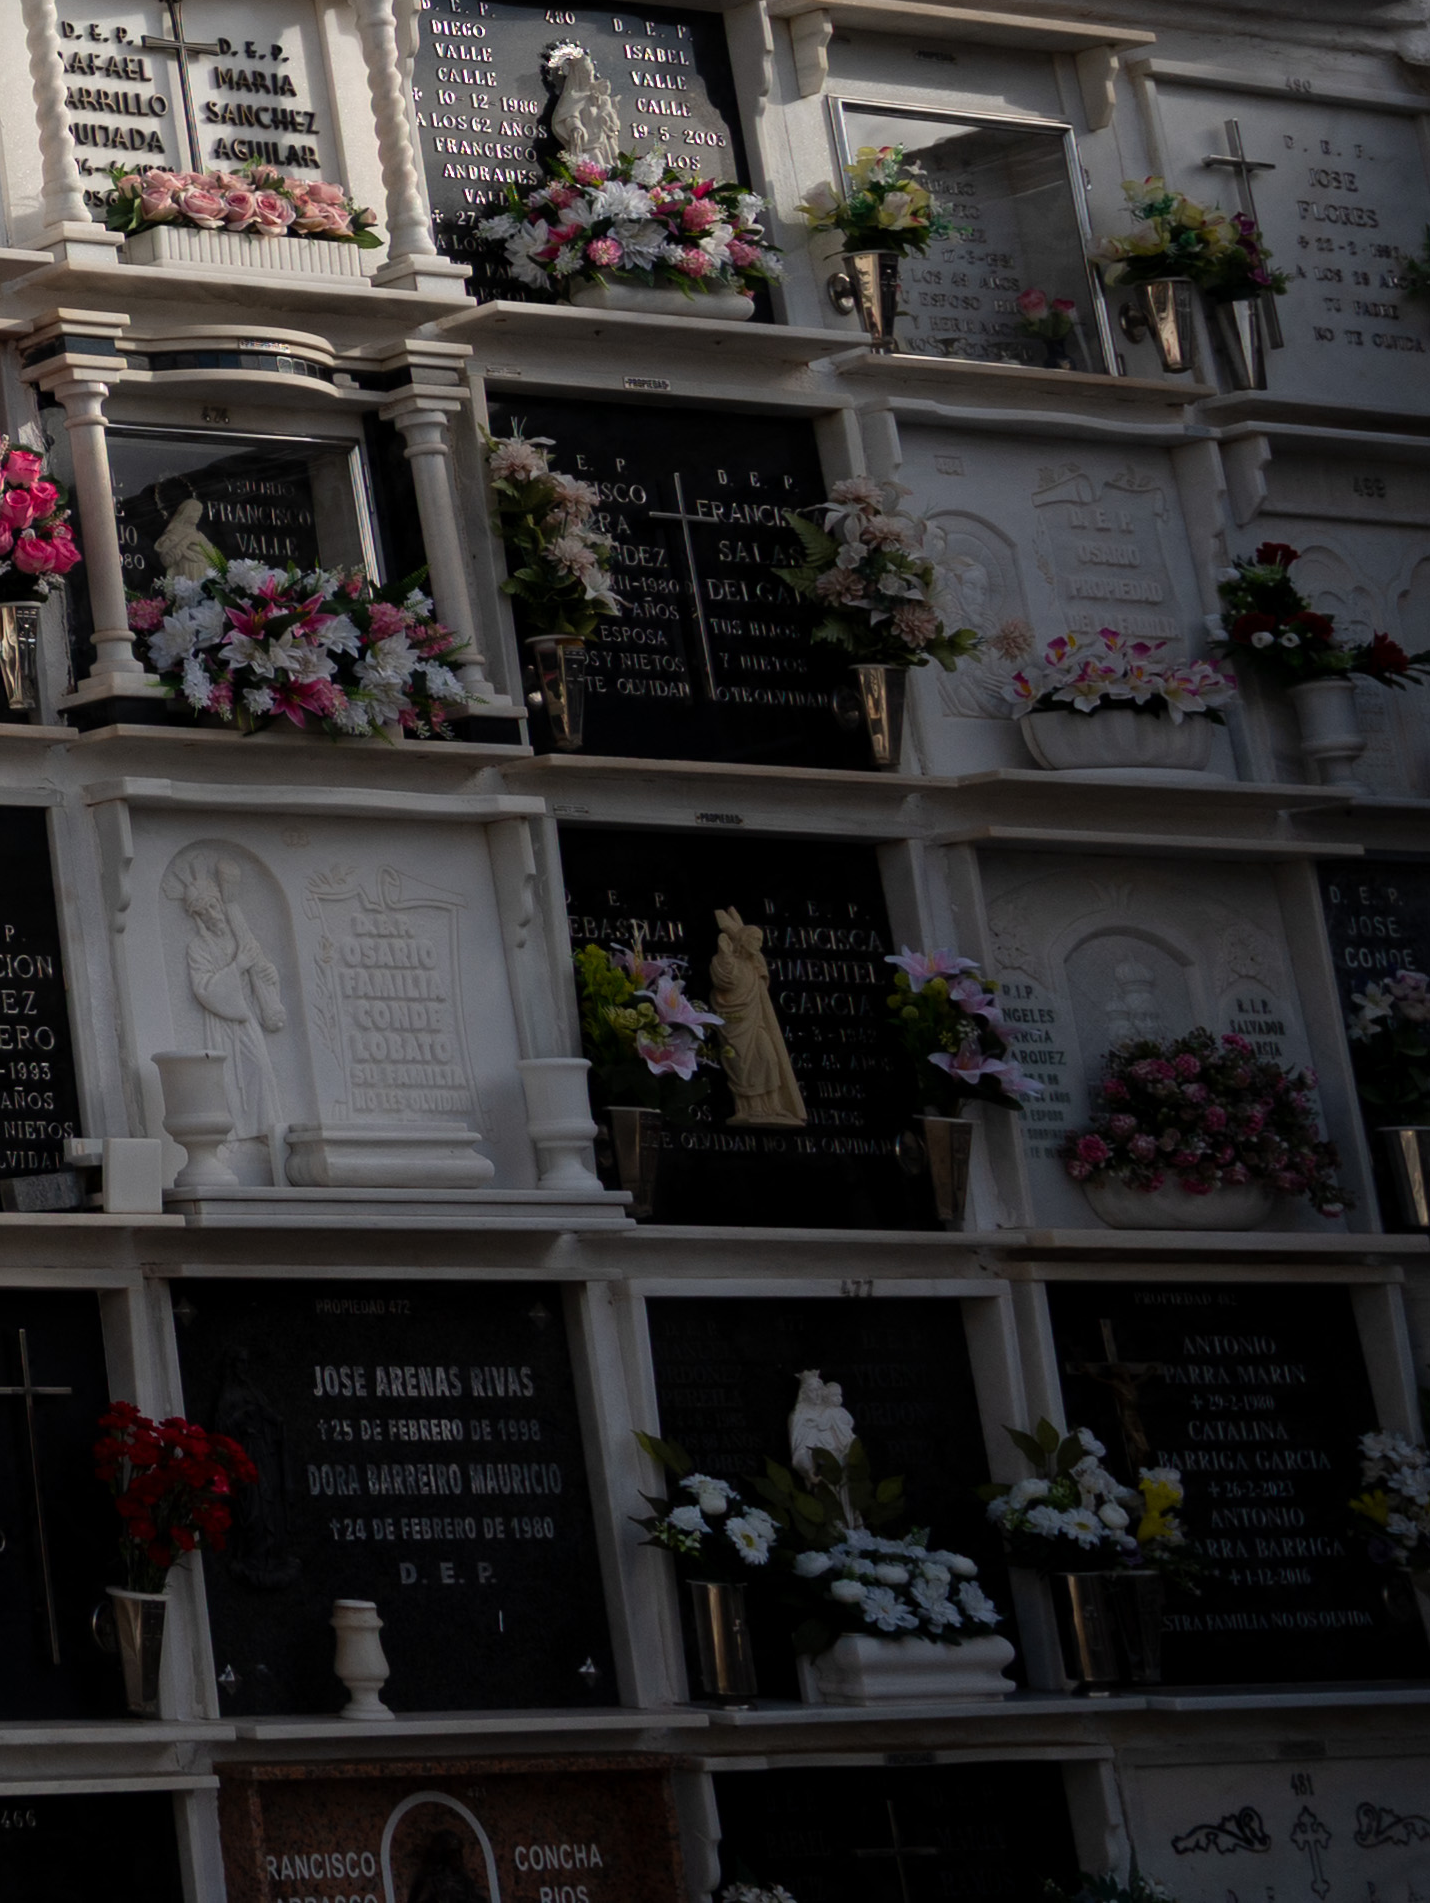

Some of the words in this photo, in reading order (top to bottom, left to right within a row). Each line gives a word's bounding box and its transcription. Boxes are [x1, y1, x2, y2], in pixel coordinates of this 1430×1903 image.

[429, 18, 487, 39] DIEGO
[544, 9, 577, 26] 480
[433, 40, 493, 62] VALLE
[623, 43, 691, 66] ISABEL
[214, 63, 297, 98] MARIA
[436, 65, 498, 86] CALLE
[630, 68, 688, 90] VALLE
[205, 100, 320, 135] SANCHEZ
[637, 97, 693, 118] CALLE
[214, 135, 322, 170] AGUILAR
[340, 939, 437, 969] OSARIO
[337, 970, 446, 1001] FAMILIA
[779, 991, 873, 1015] GARCIA
[353, 1004, 443, 1032] CONDE
[346, 1032, 453, 1062] LOBATO
[1182, 1335, 1278, 1356] ANTONIO
[312, 1367, 369, 1398] JOSE
[375, 1367, 464, 1398] ARENAS
[472, 1367, 536, 1396] RIVAS
[1187, 1420, 1289, 1442] CATALINA
[514, 1843, 604, 1872] CONCHA
